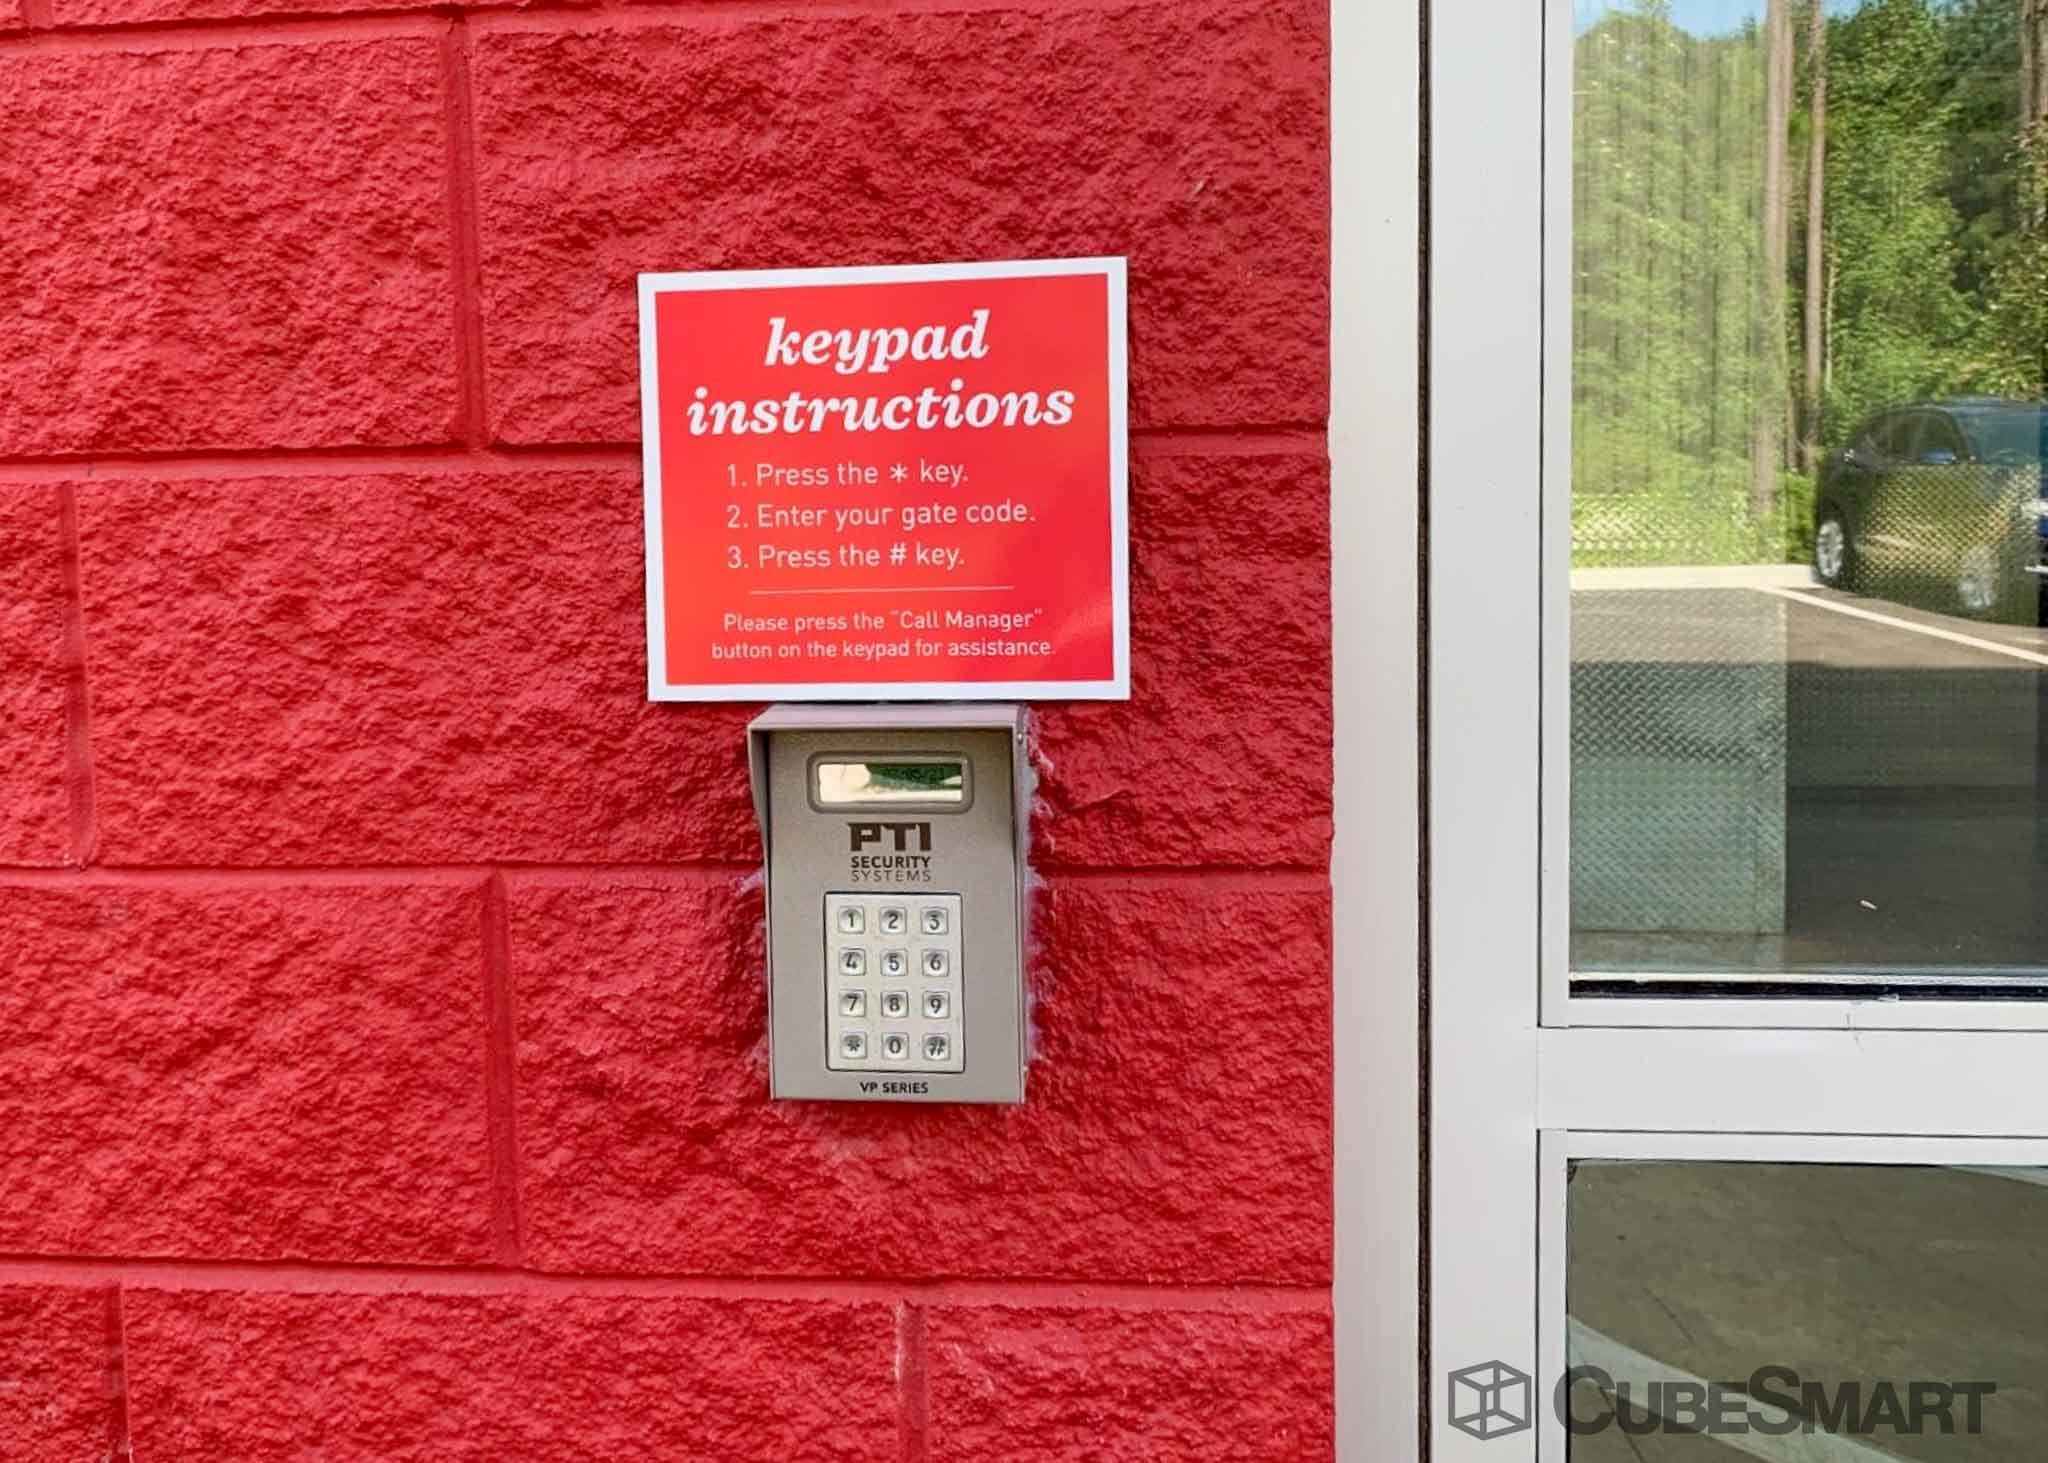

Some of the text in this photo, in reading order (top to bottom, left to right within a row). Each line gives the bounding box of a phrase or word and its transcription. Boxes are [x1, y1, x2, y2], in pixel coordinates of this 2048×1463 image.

[764, 309, 990, 375] keypad
[687, 379, 1076, 436] instructions
[727, 463, 748, 487] 1.
[756, 462, 830, 486] Press
[837, 461, 878, 484] the
[920, 459, 969, 488] key.
[727, 499, 1036, 532] 2. Enter your gate code.
[727, 542, 965, 571] 3. Press the # key.
[723, 612, 789, 632] Please
[794, 615, 848, 636] press
[852, 611, 885, 630] the
[945, 608, 1043, 633] Manager"
[711, 642, 773, 660] button
[778, 644, 801, 658] on
[807, 640, 838, 658] the
[842, 639, 909, 662] keypad
[914, 638, 943, 657] for
[847, 822, 932, 851] PTI
[850, 855, 931, 869] SECURITY
[850, 869, 931, 882] SYSTEMS
[859, 1081, 929, 1094] VP SERIES
